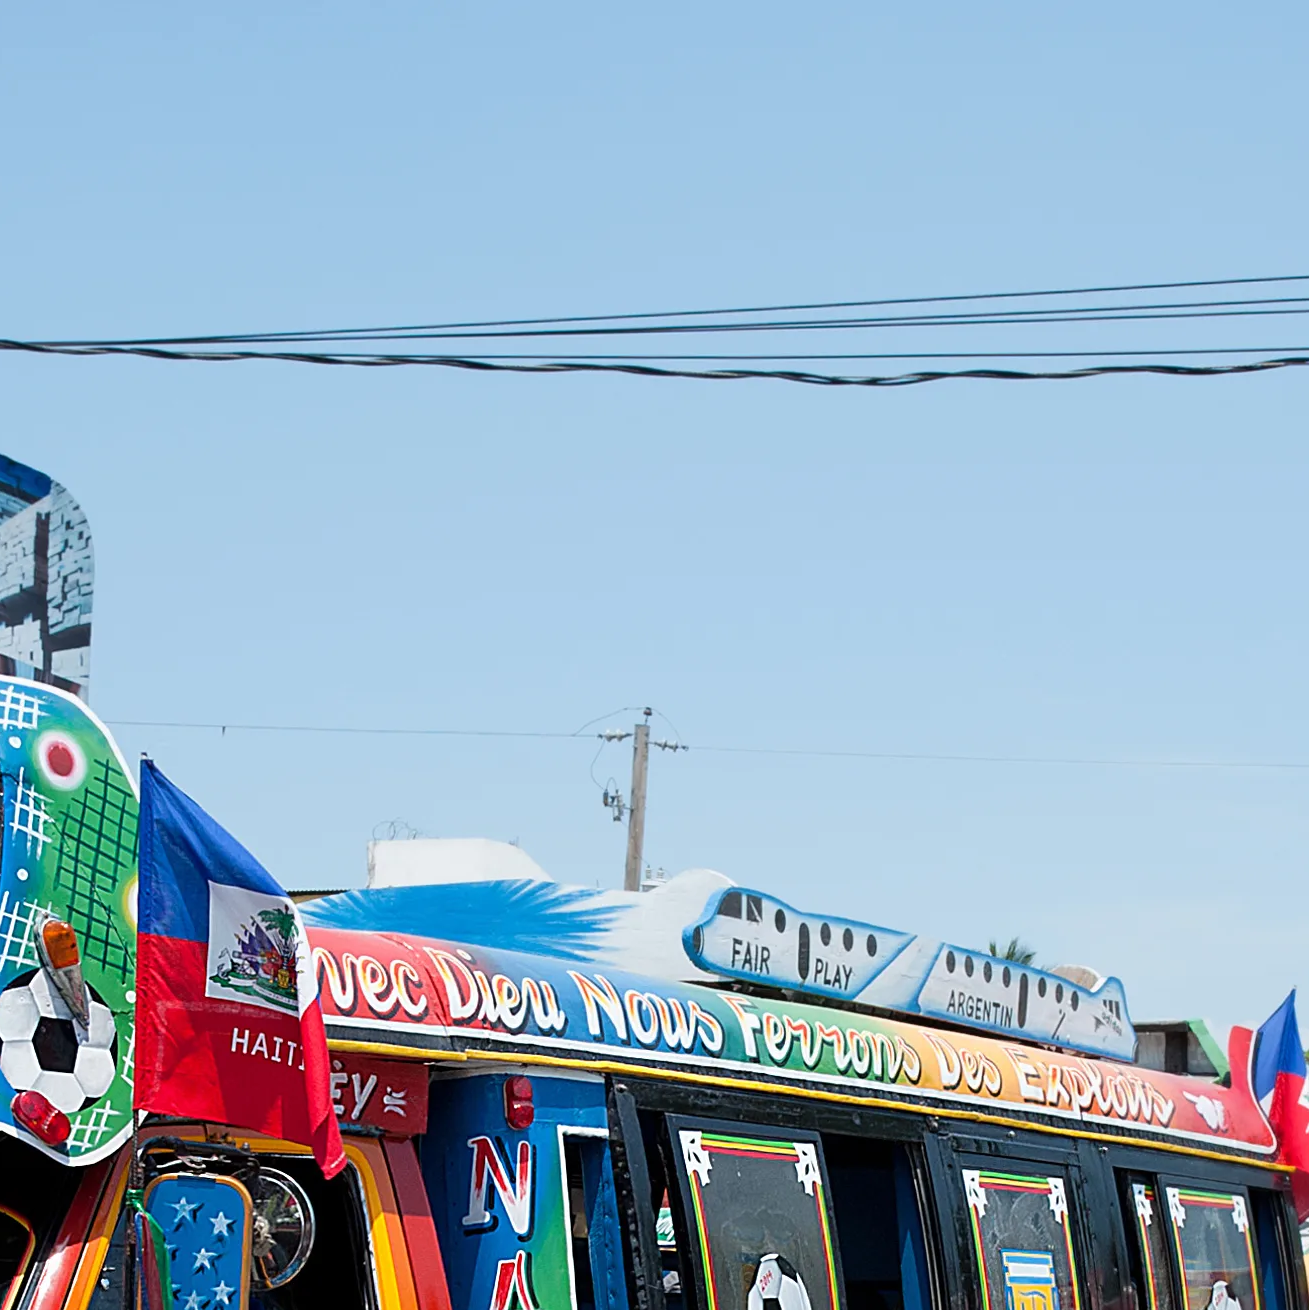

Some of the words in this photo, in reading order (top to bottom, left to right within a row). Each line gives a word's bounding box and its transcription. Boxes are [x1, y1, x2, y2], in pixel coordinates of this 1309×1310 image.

[731, 937, 771, 975] FAIR
[813, 958, 853, 991] PLAY
[946, 989, 1013, 1028] ARGENTIN
[312, 946, 428, 1017] vec
[427, 947, 566, 1034] Dieu
[567, 970, 724, 1056] Nous
[719, 993, 922, 1085] Ferrons
[921, 1030, 1002, 1097] Des
[998, 1044, 1174, 1127] Exploits
